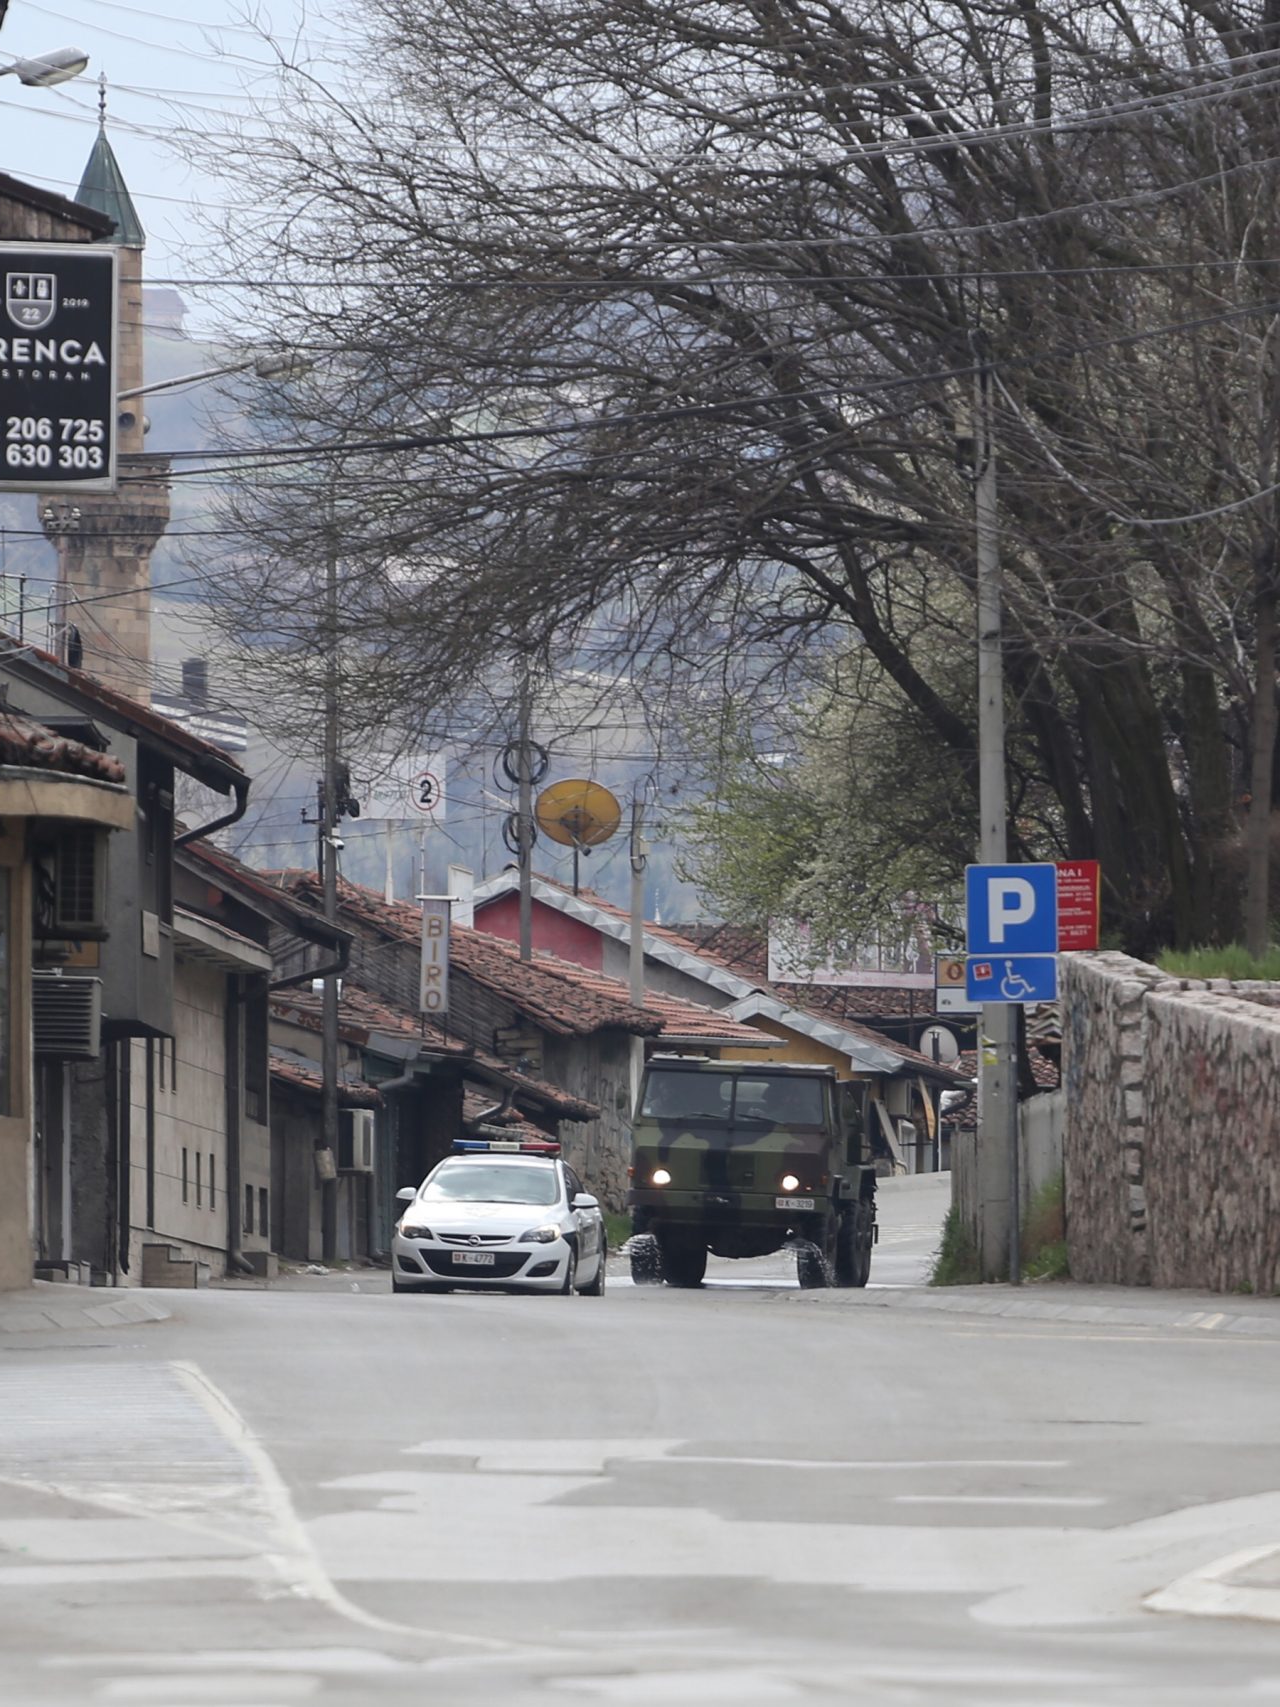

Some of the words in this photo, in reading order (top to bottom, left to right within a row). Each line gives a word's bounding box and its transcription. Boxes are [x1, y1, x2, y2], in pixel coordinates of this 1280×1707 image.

[22, 307, 40, 320] 22
[62, 298, 89, 308] 2019
[6, 417, 52, 441] 206
[59, 418, 104, 442] 725
[6, 442, 52, 467] 630
[59, 443, 104, 469] 303
[420, 780, 432, 803] 2
[987, 877, 1036, 943] P
[426, 914, 442, 1010] BIRO
